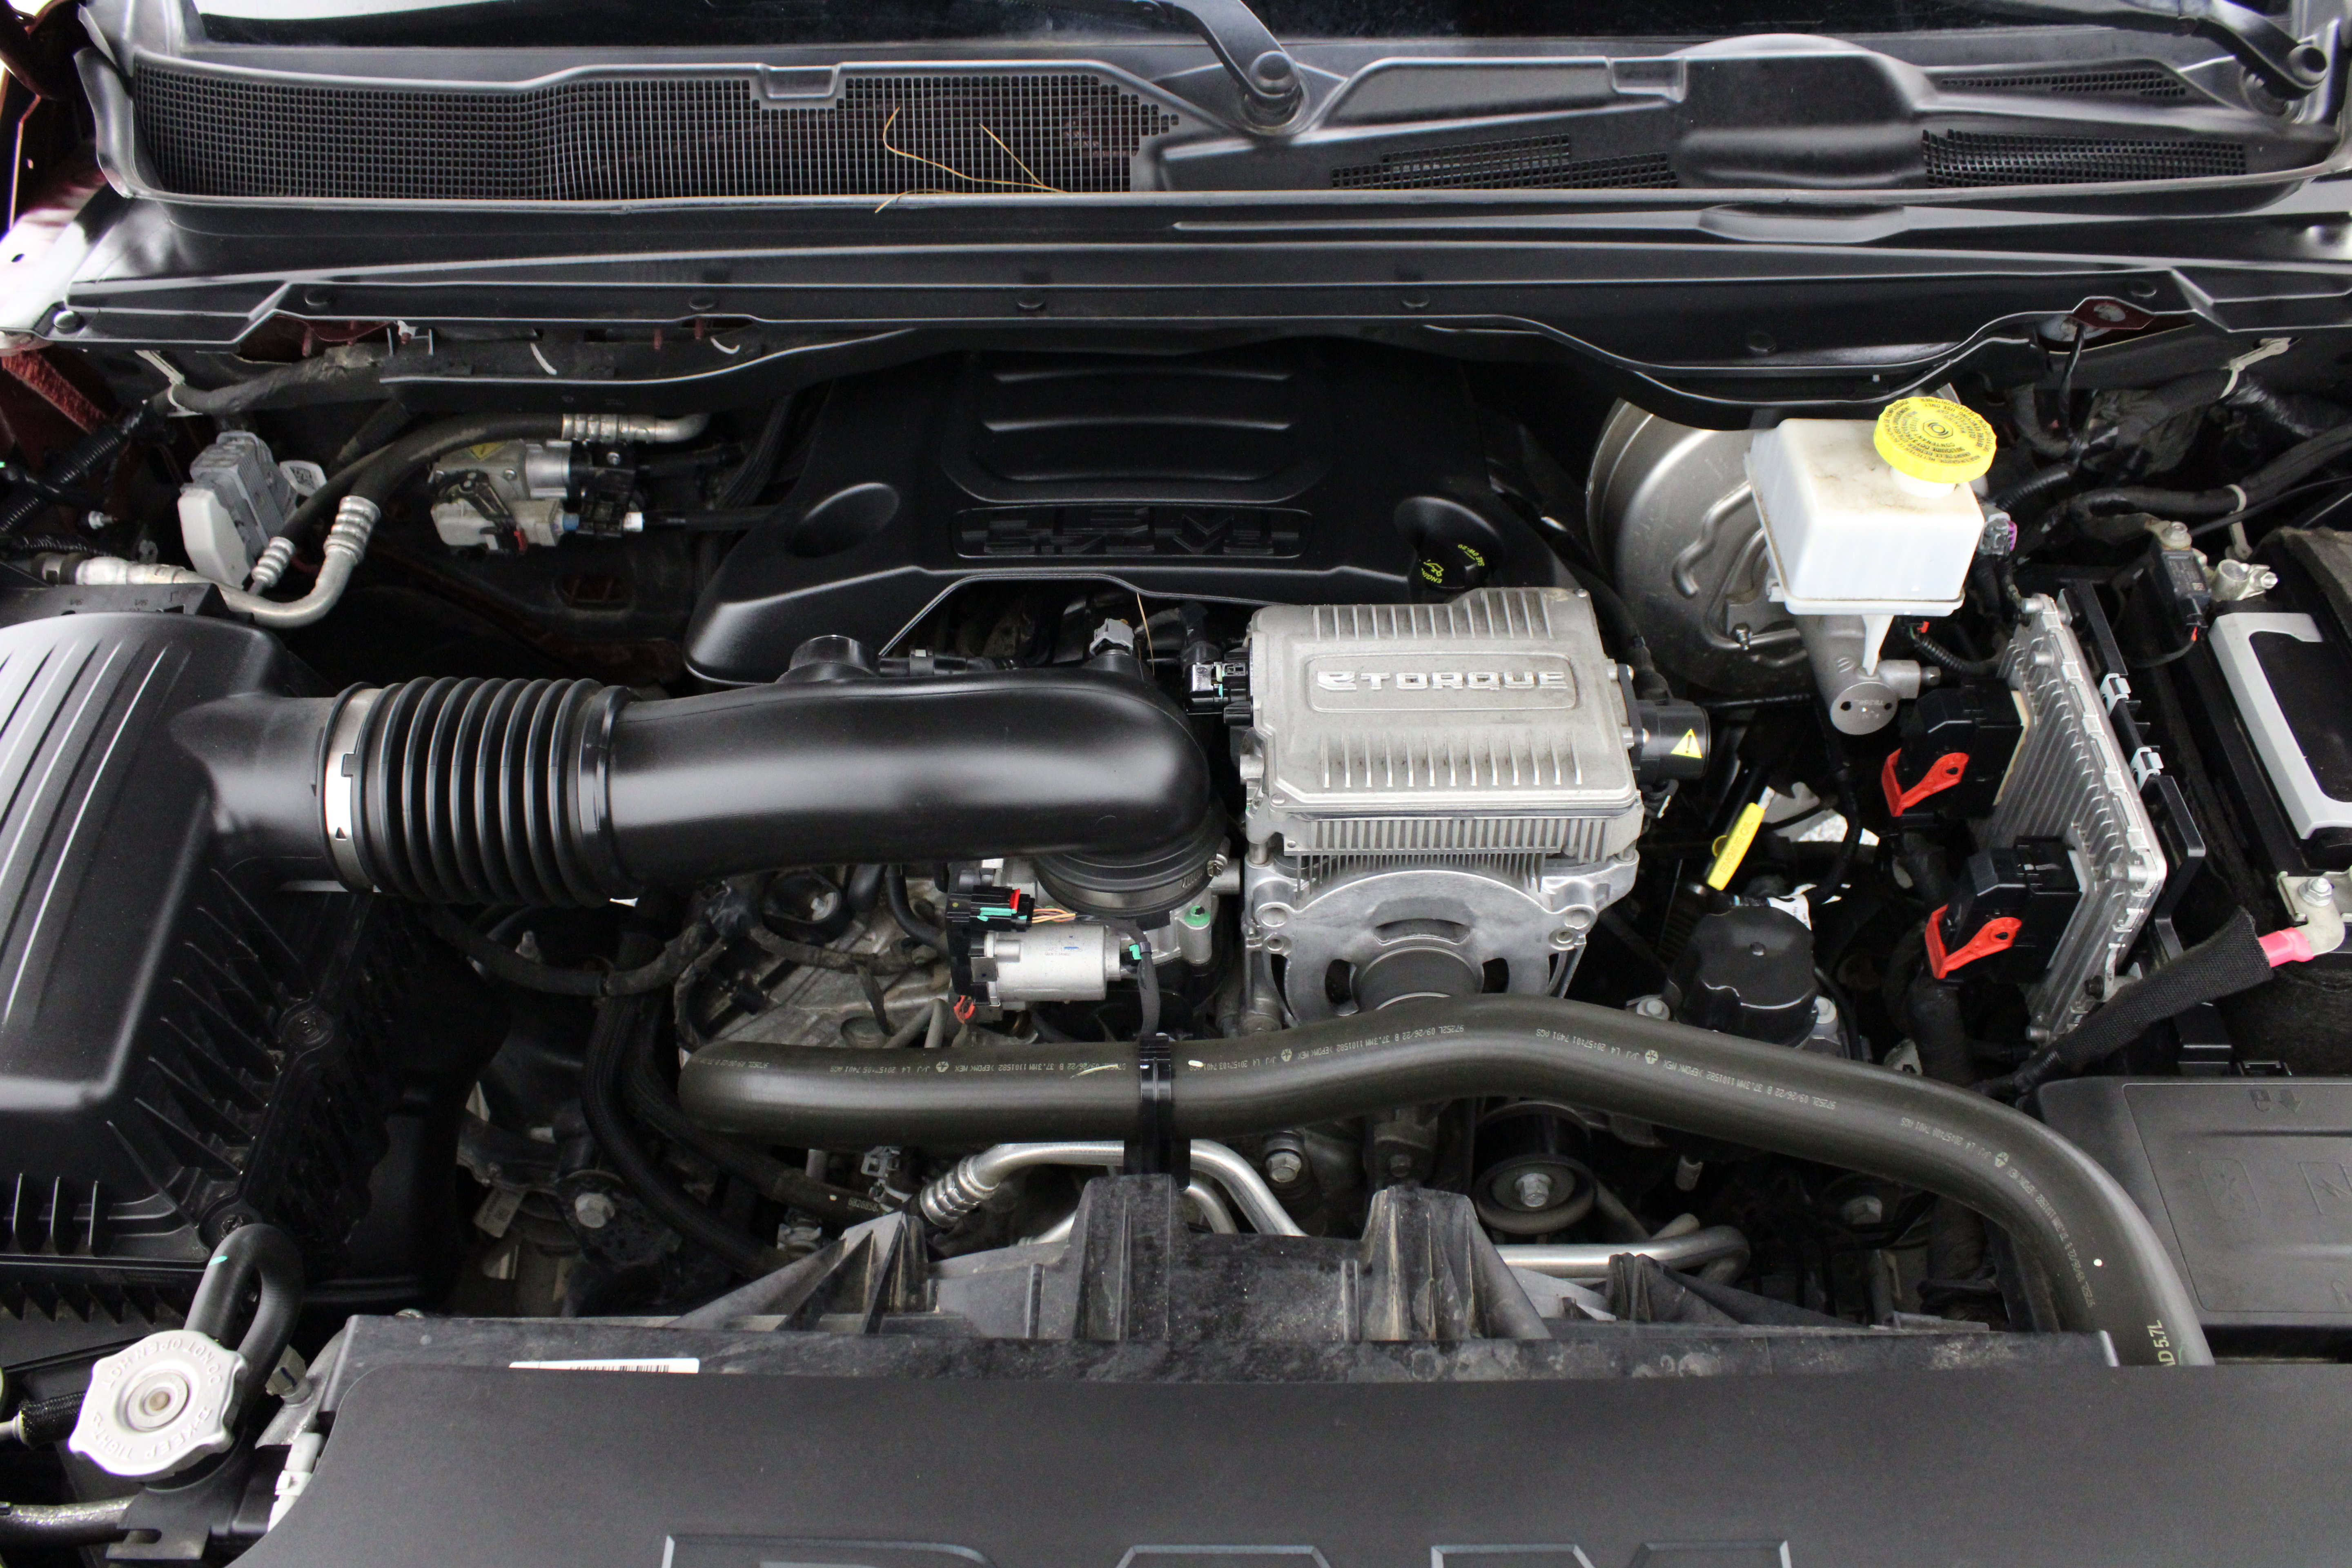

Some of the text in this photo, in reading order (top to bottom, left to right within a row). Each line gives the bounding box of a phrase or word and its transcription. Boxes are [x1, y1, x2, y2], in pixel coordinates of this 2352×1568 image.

[1476, 557, 1485, 566] SAE
[1719, 821, 1754, 874] ENGINE OIL
[1402, 1027, 1435, 1040] 09/26/22
[1438, 1025, 1465, 1034] 97252L
[1536, 1029, 1550, 1038] AGS
[1336, 1040, 1363, 1051] 1101582
[1365, 1035, 1390, 1045] 37.3MM
[1572, 1036, 1606, 1051] 20:57:01
[1298, 1050, 1309, 1059] MEX
[1611, 1046, 1620, 1056] L4
[1203, 1062, 1217, 1071] 7401
[1663, 1060, 1677, 1071] MEX
[1706, 1071, 1735, 1086] 1101582
[1767, 1086, 1773, 1094] B
[1775, 1088, 1809, 1104] 09/26/22
[2147, 1319, 2169, 1348] 5.7L
[135, 1339, 181, 1361] OPEN
[183, 1340, 216, 1365] NOT
[101, 1357, 134, 1390] HOT
[91, 1427, 197, 1461] KEEP TIGHT
